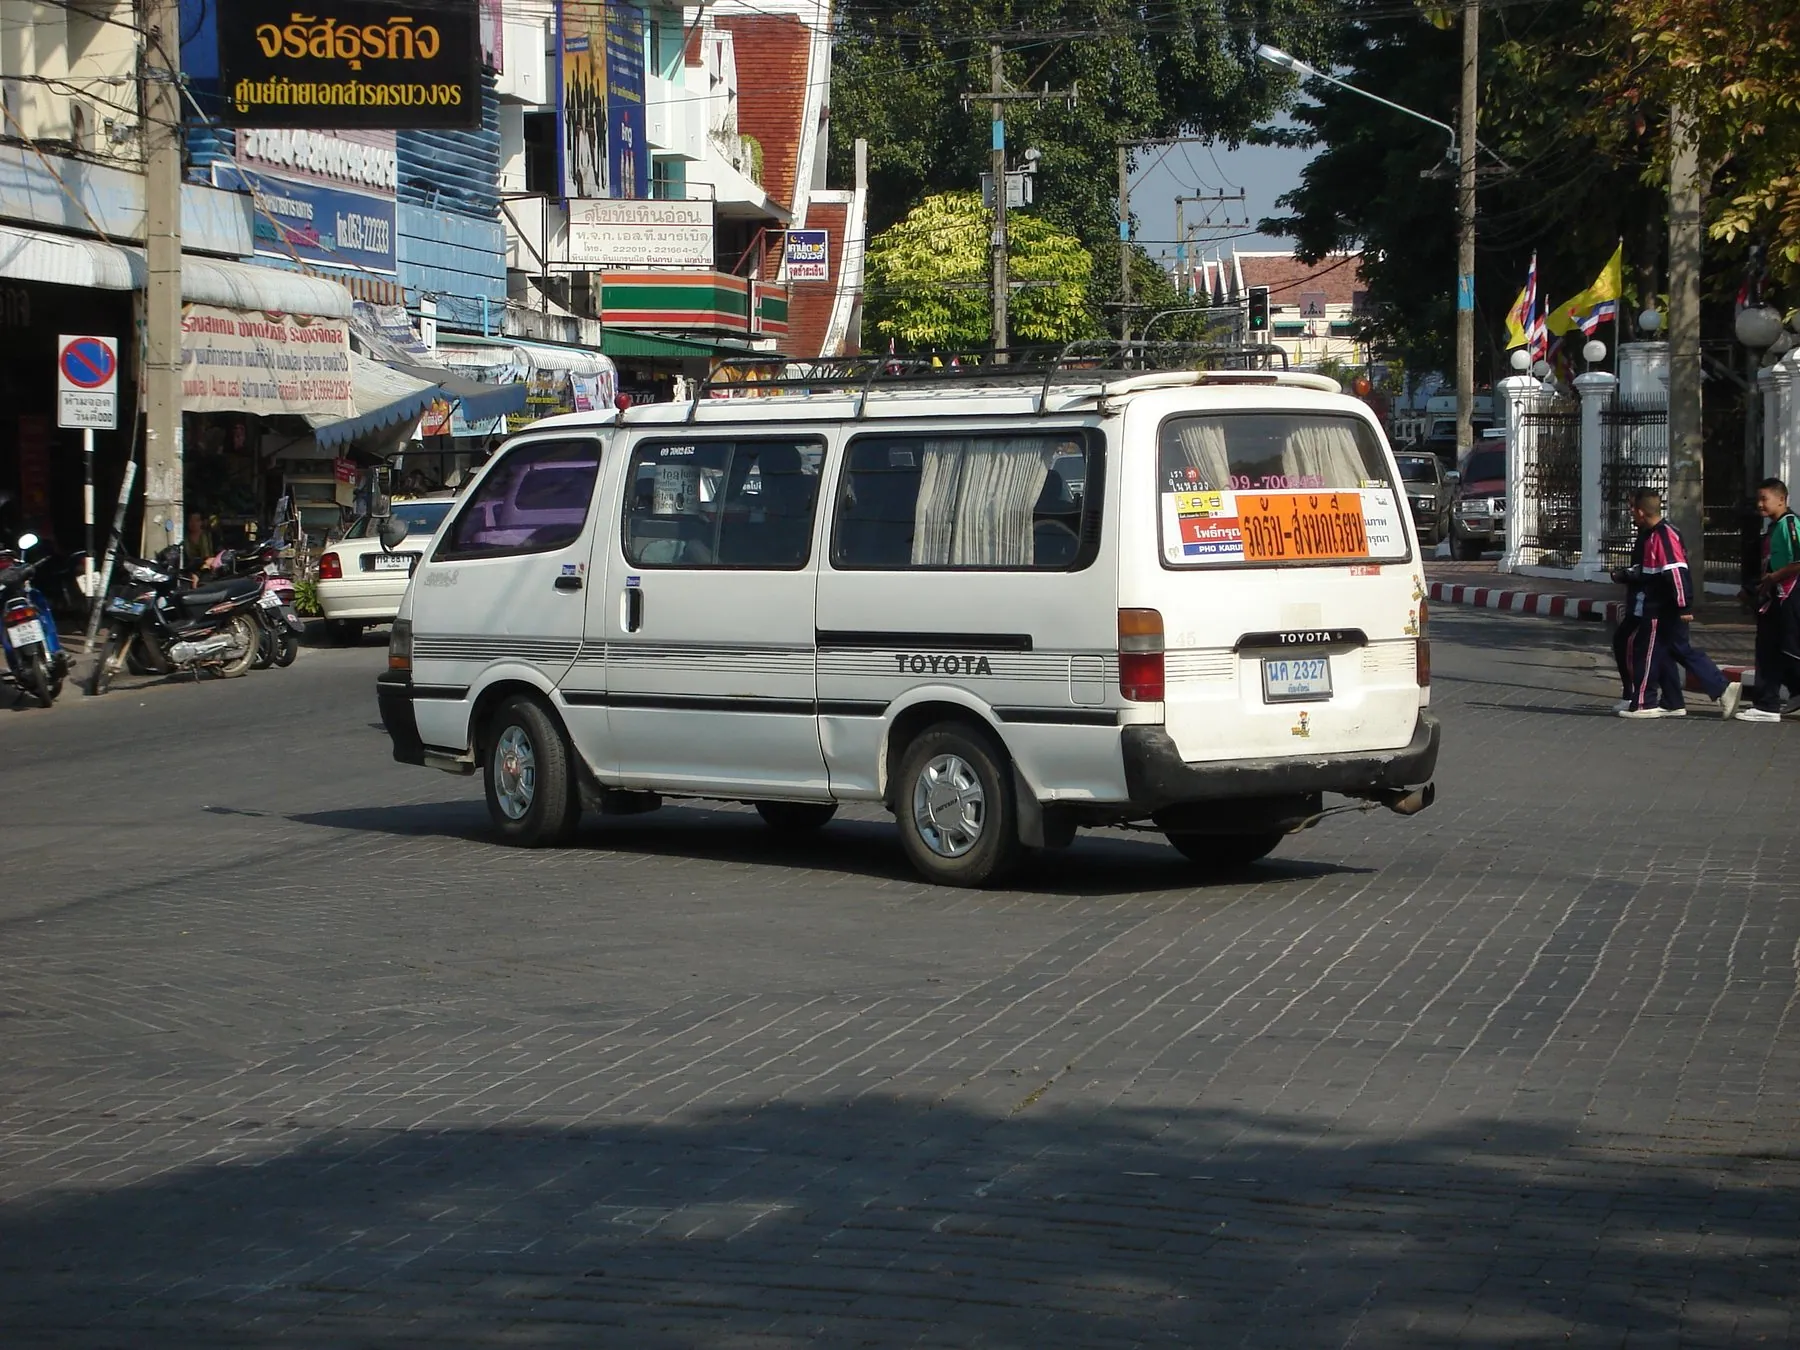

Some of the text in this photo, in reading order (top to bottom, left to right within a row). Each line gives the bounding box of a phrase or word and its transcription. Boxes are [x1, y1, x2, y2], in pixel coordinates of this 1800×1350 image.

[256, 13, 440, 70] จรัสธุรกิจ
[235, 76, 462, 113] ศูนย์ถ่ายเอกสารครบวงจร
[584, 202, 703, 228] สุโขทัยหินอ่อน
[65, 393, 111, 407] ห้ามจอด
[1170, 470, 1183, 478] เรา
[1168, 479, 1209, 492] ในหลวง
[1243, 495, 1367, 558] รถรับ-ส่งนักเรียน
[1199, 545, 1217, 553] PHO
[1280, 632, 1331, 643] TOYOTA
[895, 655, 992, 676] TOYOTA
[1293, 660, 1325, 680] 2327
